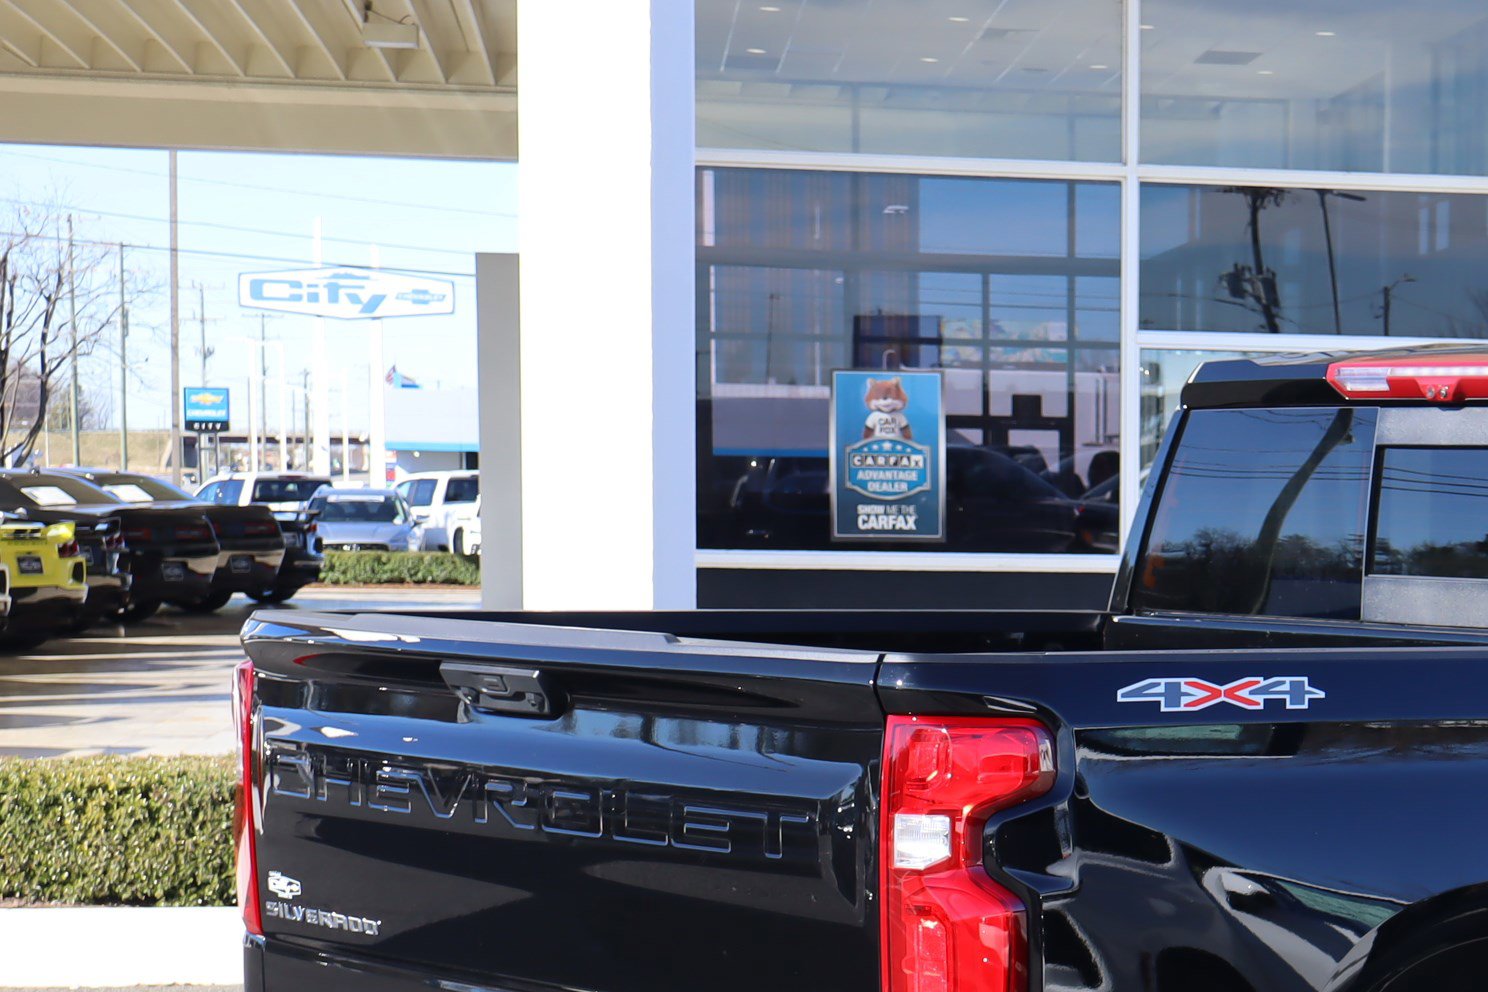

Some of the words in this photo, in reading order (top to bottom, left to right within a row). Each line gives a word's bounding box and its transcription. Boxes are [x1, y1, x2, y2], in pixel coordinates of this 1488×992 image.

[249, 279, 388, 314] City
[878, 417, 897, 425] CAR
[879, 426, 897, 434] FOX
[852, 454, 925, 468] CARFAX
[856, 469, 918, 481] ADVANTAGE
[867, 481, 909, 492] DEALER
[857, 504, 885, 515] SHOW
[886, 504, 900, 514] ME
[901, 504, 916, 514] THE
[857, 514, 917, 530] CARFAX
[268, 750, 811, 859] CHEVROLET
[266, 900, 381, 936] SILVERADO
